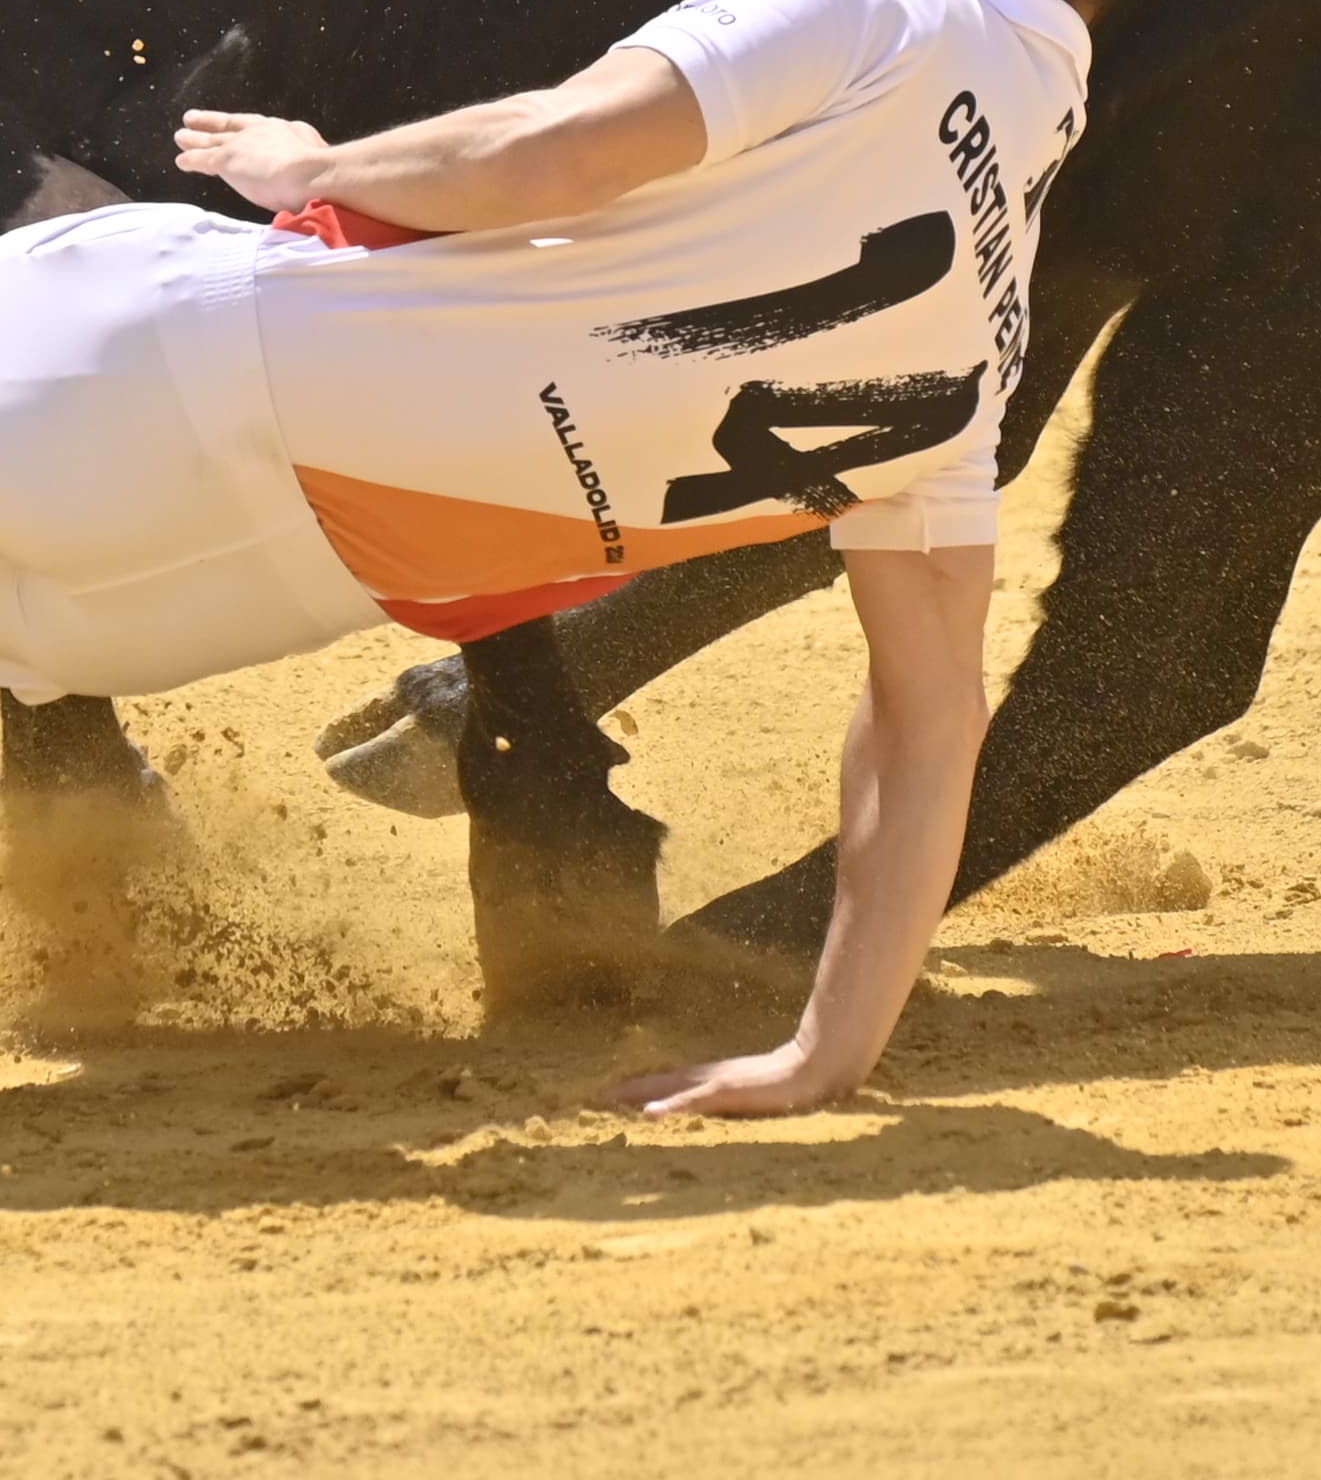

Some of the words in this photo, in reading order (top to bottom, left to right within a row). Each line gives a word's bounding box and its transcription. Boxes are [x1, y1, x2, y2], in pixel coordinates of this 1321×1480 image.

[938, 90, 1014, 301] CRISTIAN
[539, 381, 621, 543] VALLADOLID
[588, 209, 989, 524] 14
